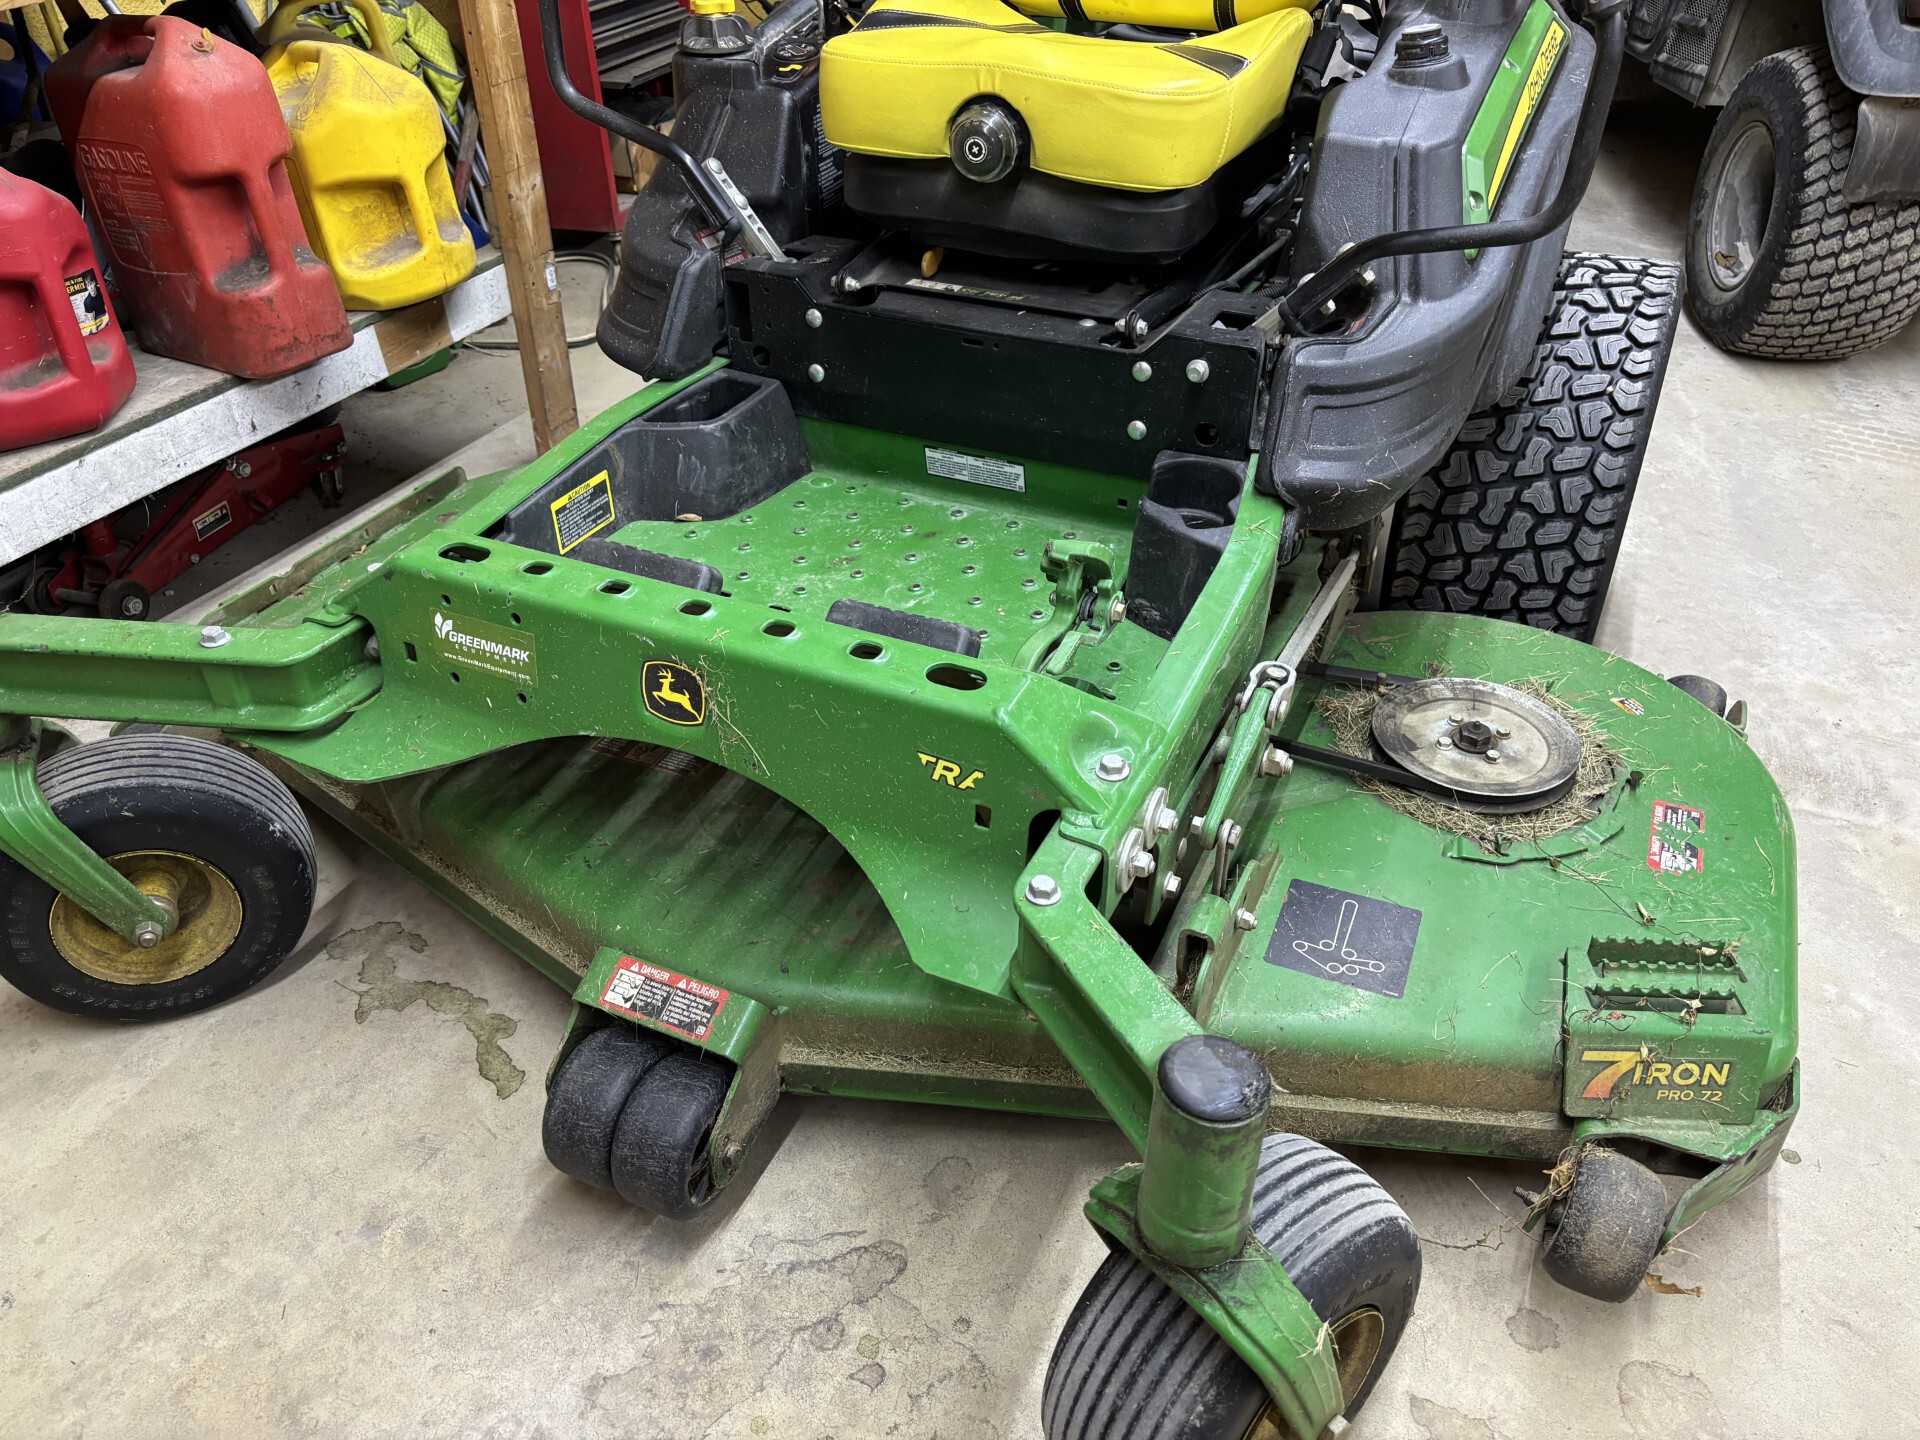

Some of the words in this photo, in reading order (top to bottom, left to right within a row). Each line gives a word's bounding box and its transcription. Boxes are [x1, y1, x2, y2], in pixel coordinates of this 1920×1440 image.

[80, 144, 153, 175] GASOLINE
[571, 482, 591, 499] CAUTION
[448, 631, 530, 662] GREENMARK
[455, 644, 524, 667] EQUIPMENT
[640, 964, 670, 982] DANGER
[688, 981, 720, 999] PELIGRO
[1582, 1050, 1641, 1098] 7
[1632, 1063, 1731, 1086] IRON
[1656, 1090, 1695, 1101] PRO
[1701, 1091, 1723, 1102] 72
